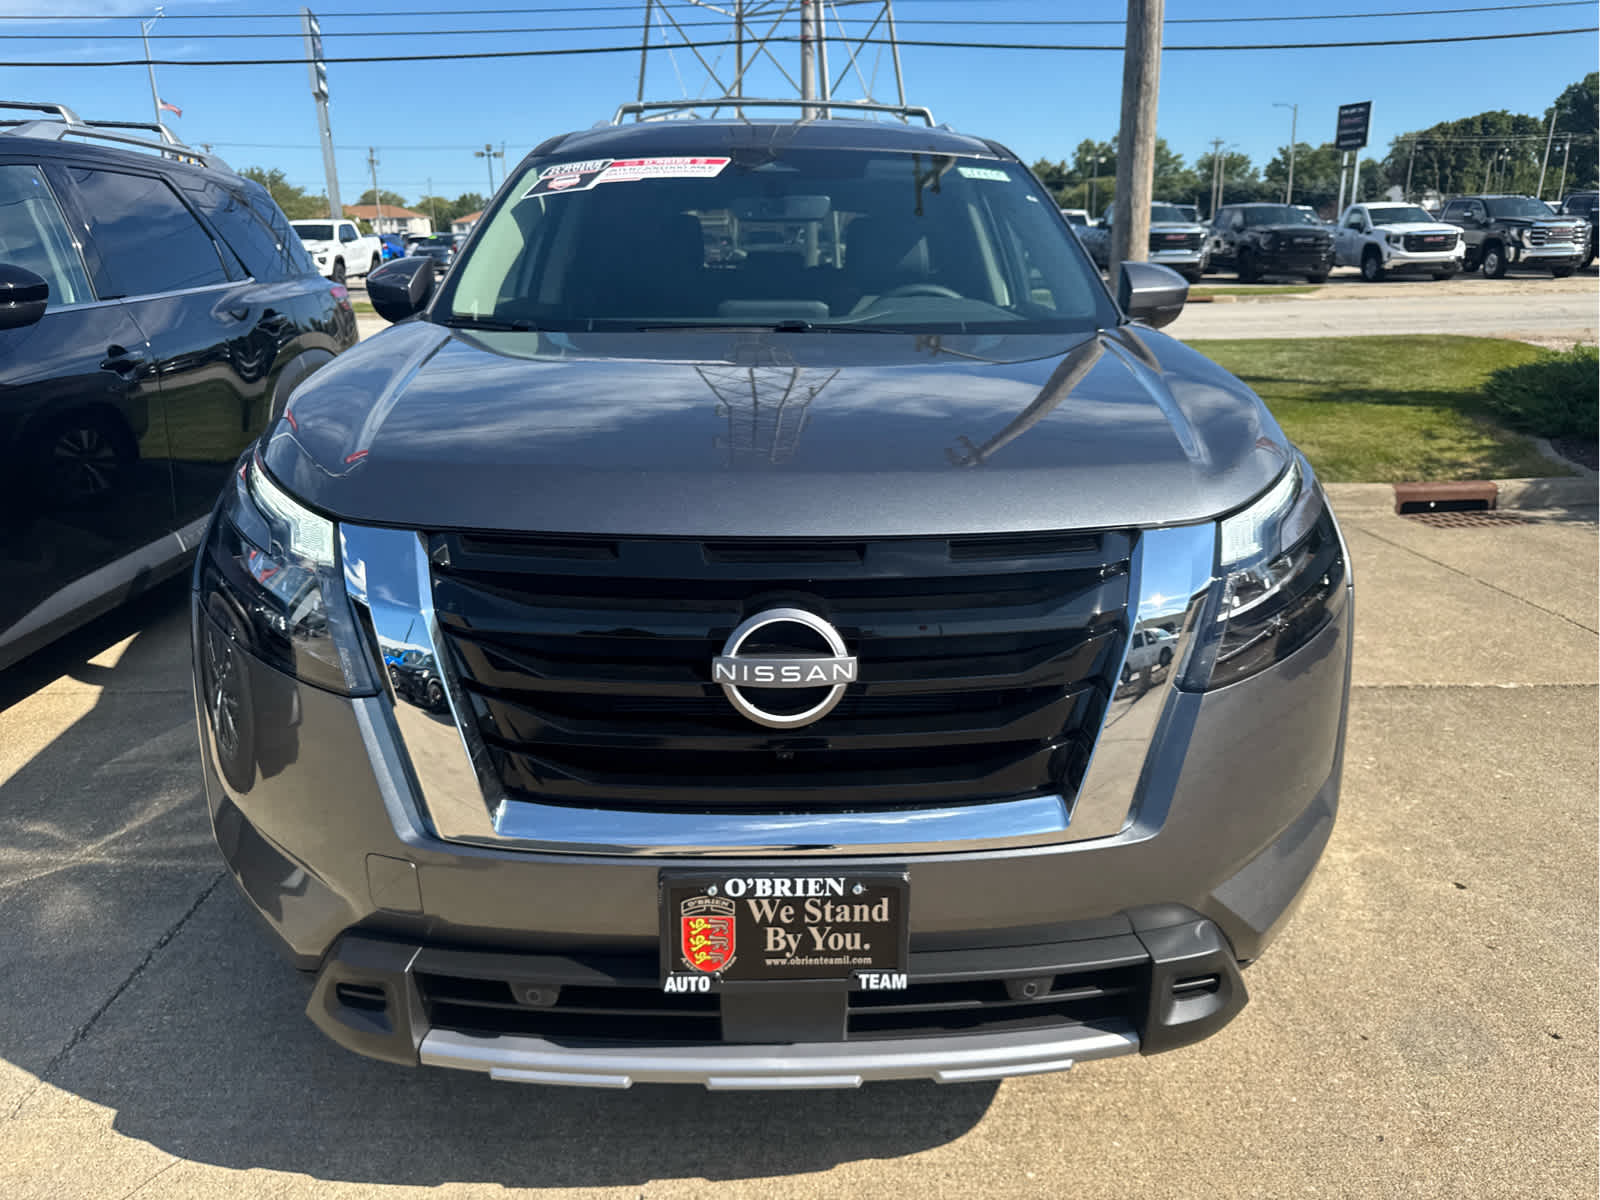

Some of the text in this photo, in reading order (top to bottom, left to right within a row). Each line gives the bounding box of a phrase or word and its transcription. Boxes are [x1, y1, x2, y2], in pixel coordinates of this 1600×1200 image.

[716, 662, 854, 683] NISSAN
[724, 877, 846, 898] O'BRIEN
[747, 897, 889, 924] We Stand
[764, 926, 871, 958] By You.
[764, 955, 873, 966] www.obrienteamil.com
[664, 976, 710, 992] AUTO
[858, 974, 907, 990] TEAM
